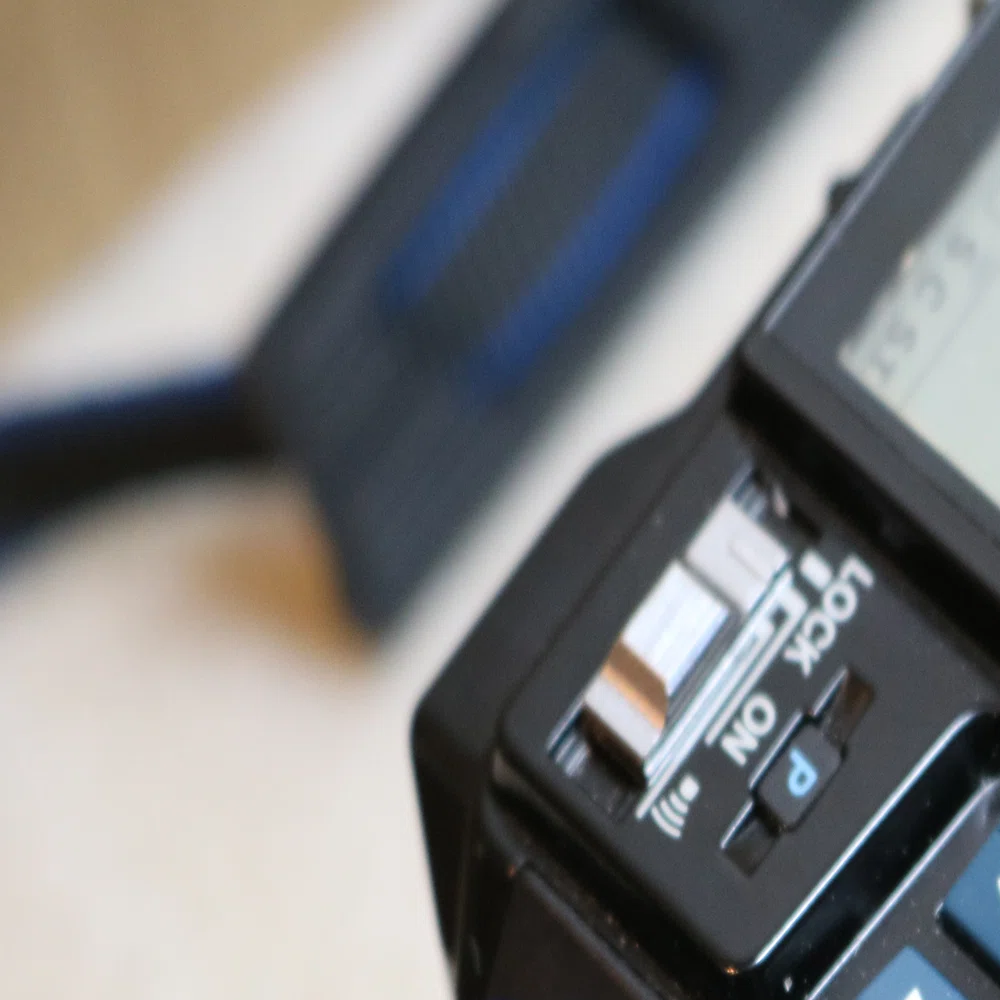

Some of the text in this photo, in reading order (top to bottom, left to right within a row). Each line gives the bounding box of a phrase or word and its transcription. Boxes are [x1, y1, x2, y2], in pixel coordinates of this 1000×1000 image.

[782, 552, 876, 677] LOCK
[720, 694, 778, 768] ON
[787, 747, 819, 798] P
